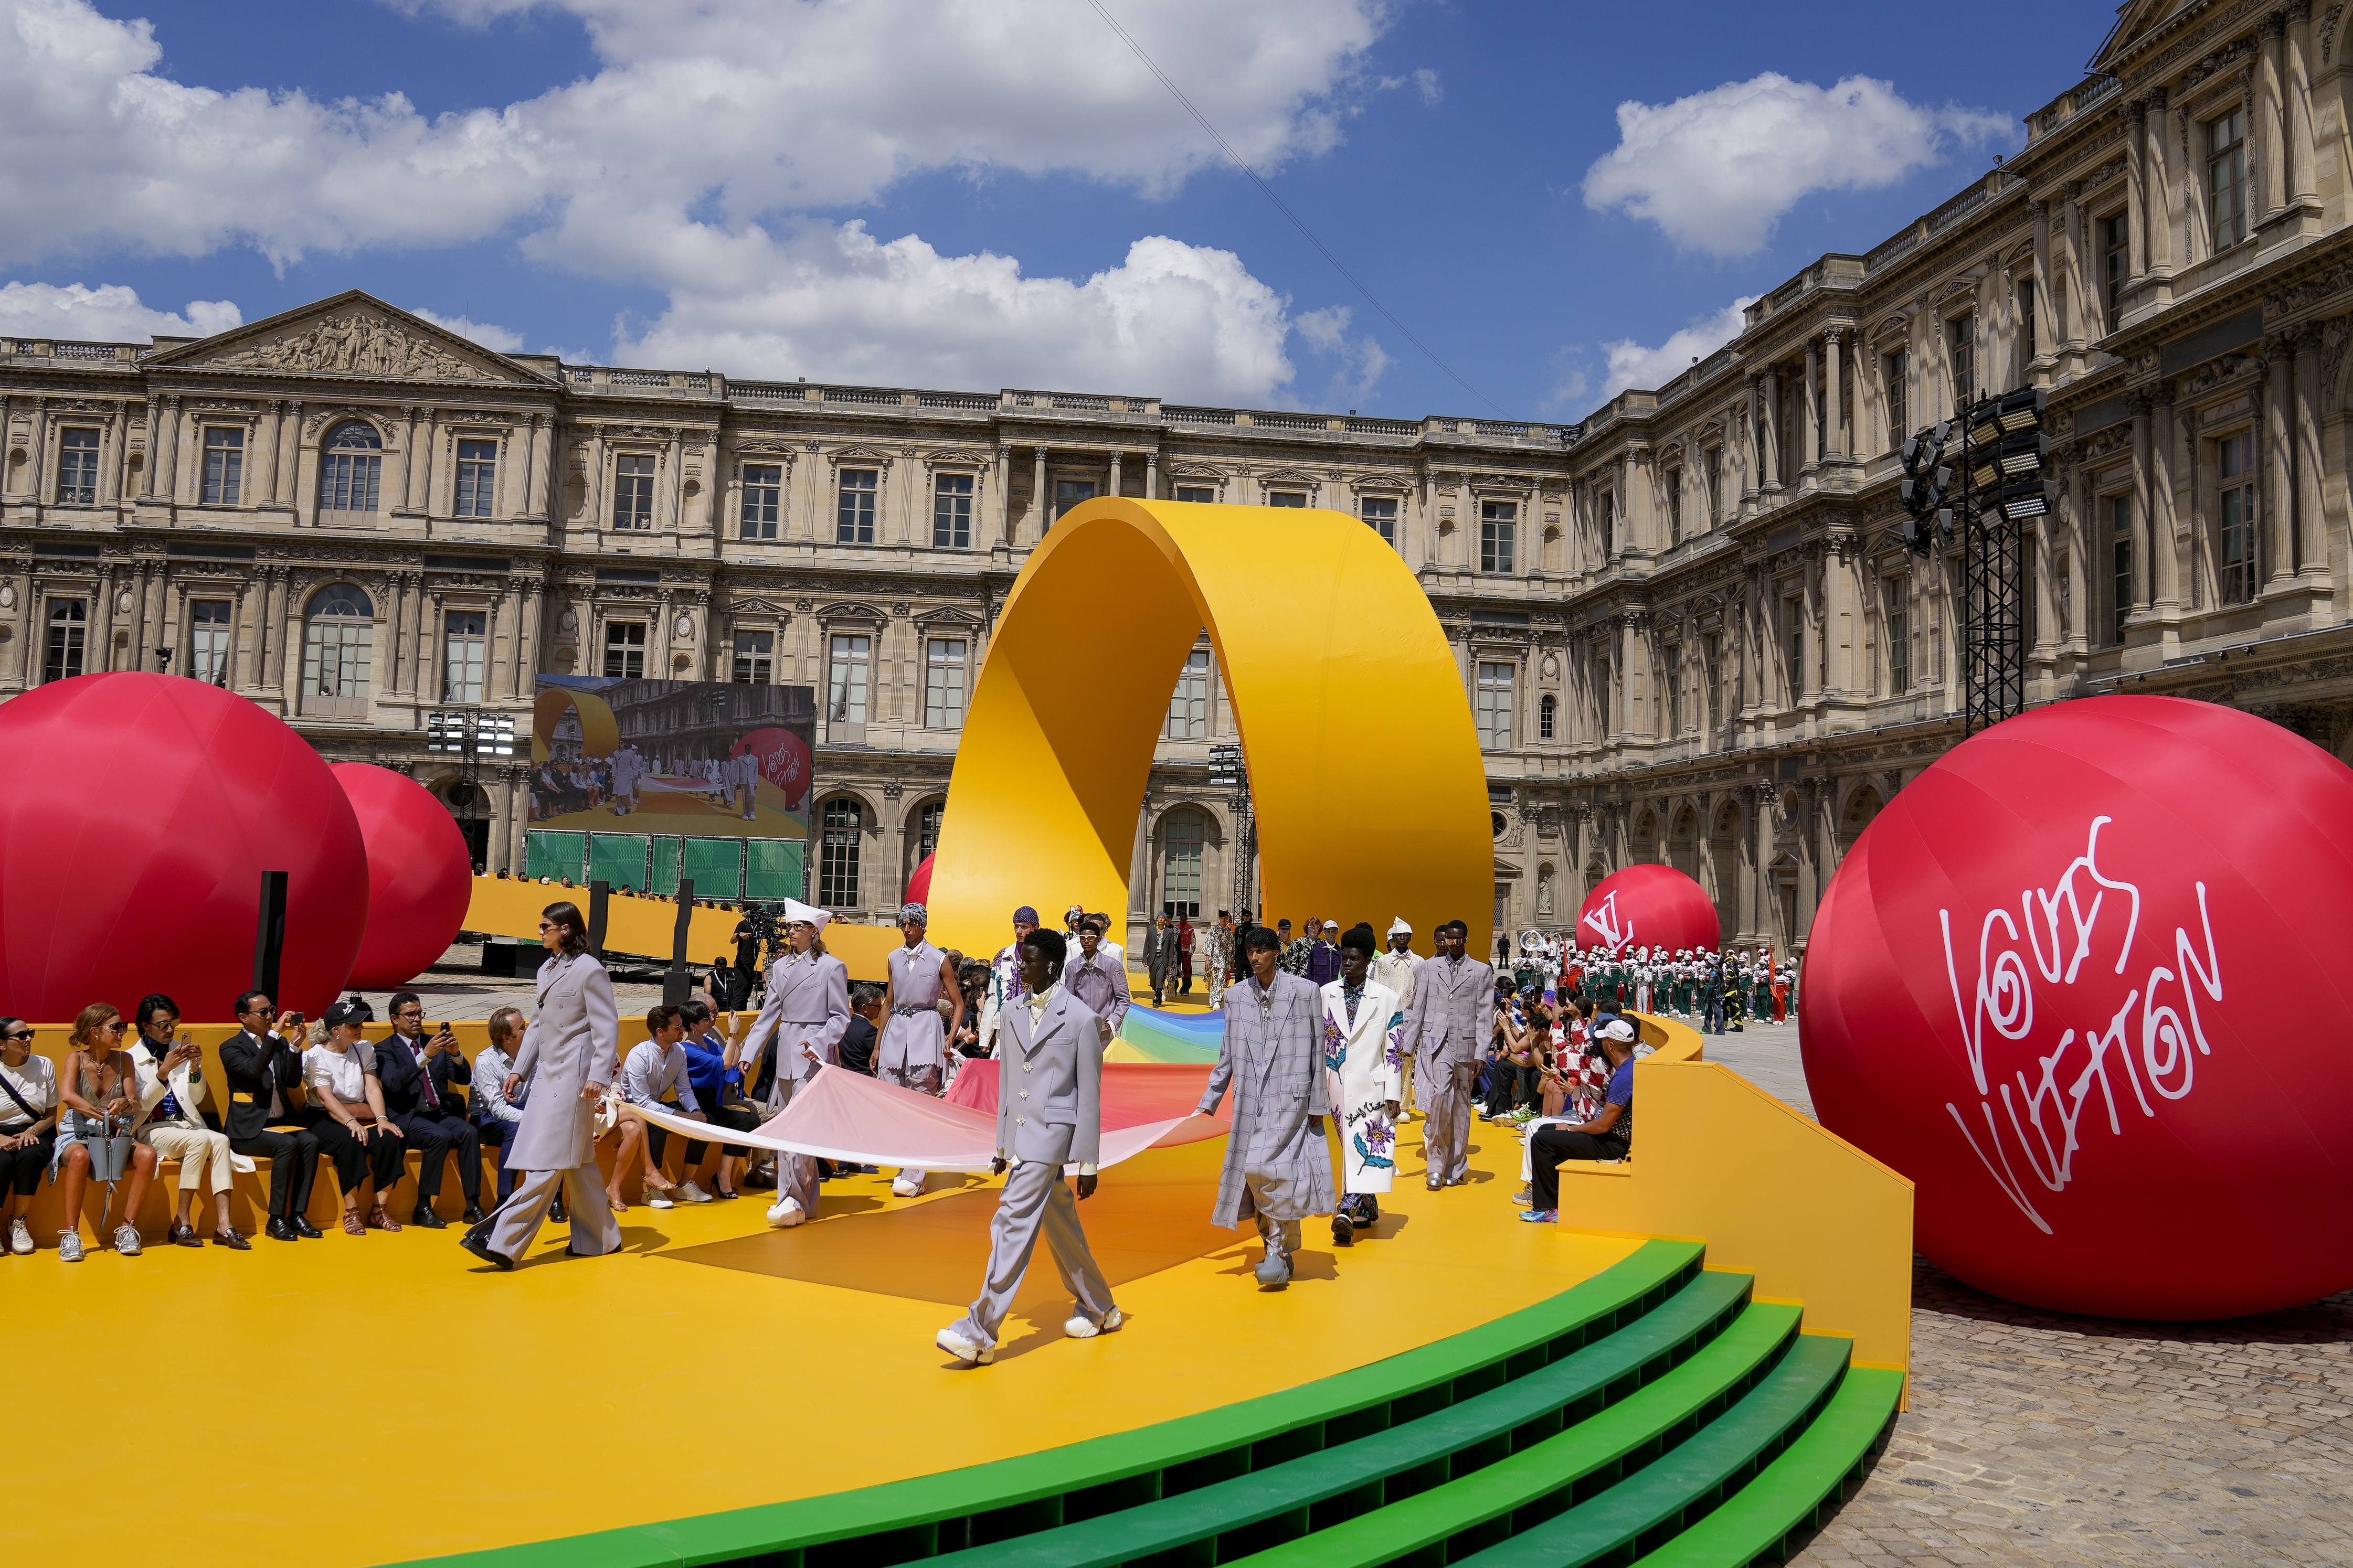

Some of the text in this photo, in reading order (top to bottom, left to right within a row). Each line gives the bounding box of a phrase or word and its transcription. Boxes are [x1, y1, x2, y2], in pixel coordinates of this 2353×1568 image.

[1938, 815, 2140, 1095] LOUIS
[1946, 881, 2223, 1235] VUITTON
[1344, 1107, 1366, 1127] Louis
